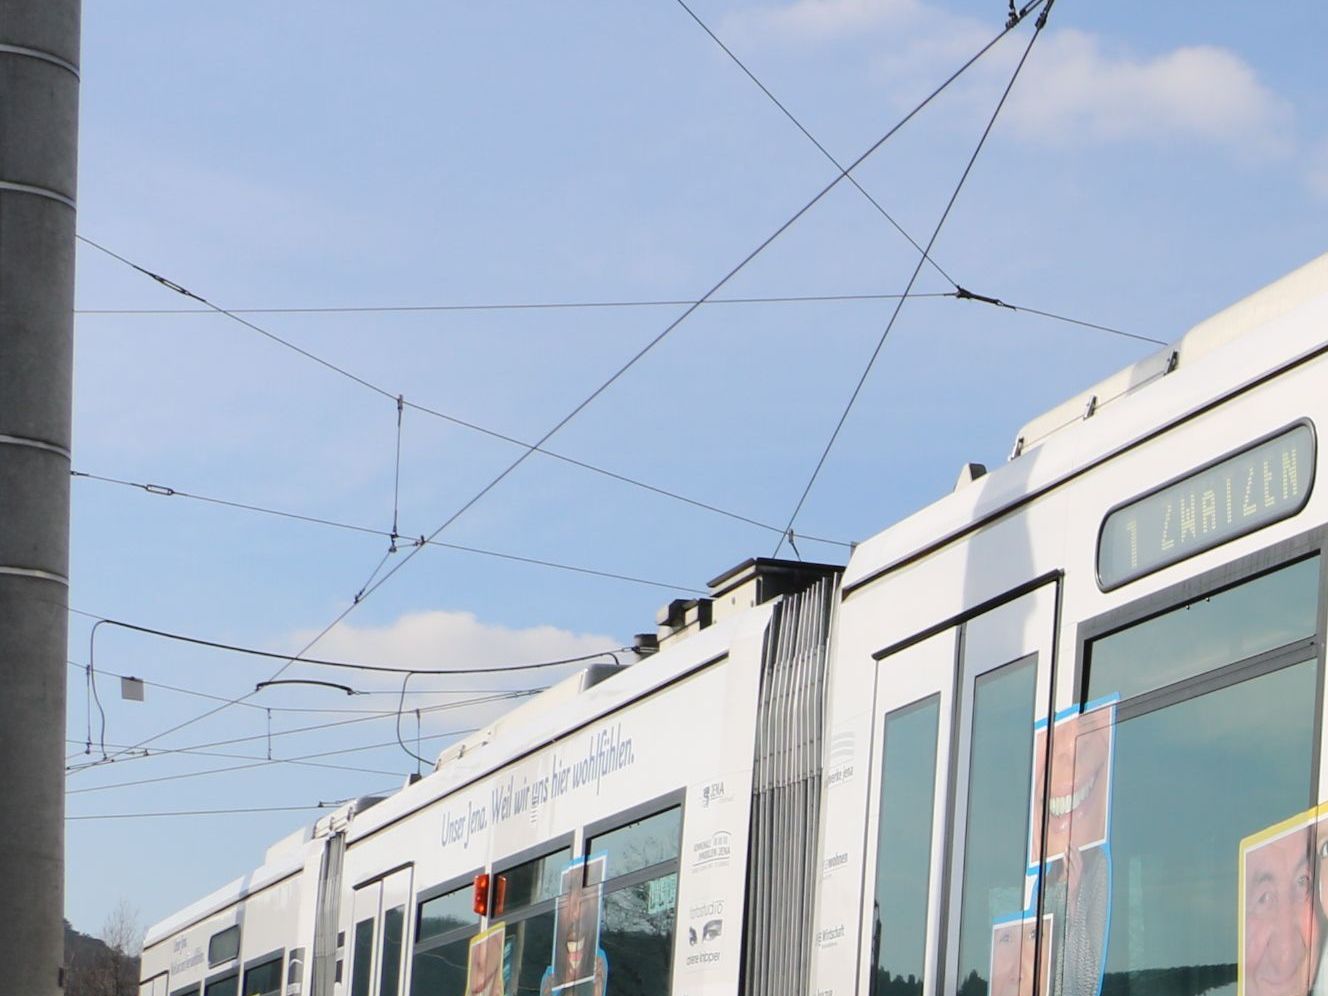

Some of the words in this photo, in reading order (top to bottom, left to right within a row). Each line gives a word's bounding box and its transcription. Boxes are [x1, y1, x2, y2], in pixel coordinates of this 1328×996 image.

[441, 813, 466, 847] Unser
[464, 801, 487, 849] Jena.
[491, 775, 514, 825] Weil
[514, 777, 530, 815] wir
[551, 754, 571, 799] hier
[572, 722, 635, 796] wohlfühlen.
